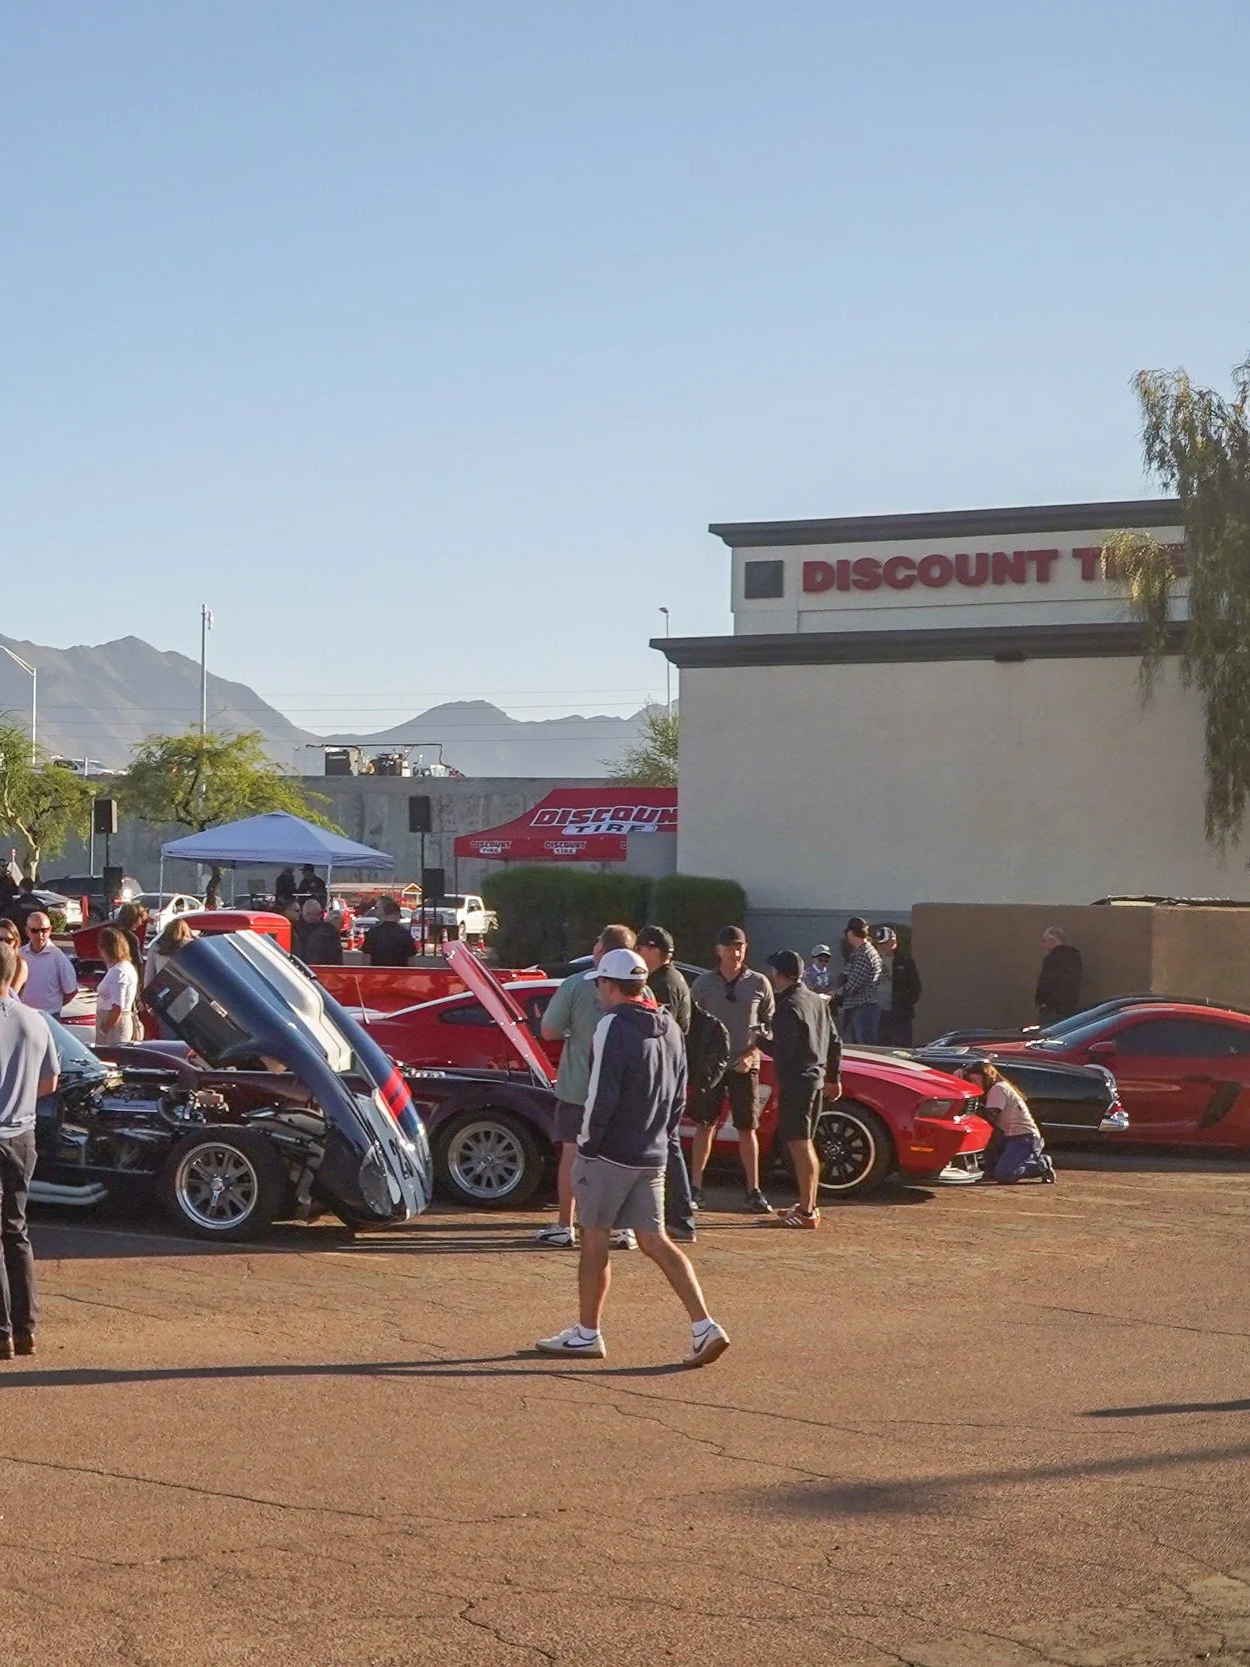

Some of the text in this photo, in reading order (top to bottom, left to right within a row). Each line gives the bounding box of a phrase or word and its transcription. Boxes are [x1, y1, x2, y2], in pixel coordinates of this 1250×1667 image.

[803, 549, 1059, 592] DISCOUNT
[530, 806, 678, 827] DISCOUN
[470, 840, 511, 849] DISCOUNT
[545, 841, 587, 849] DISCOUNT
